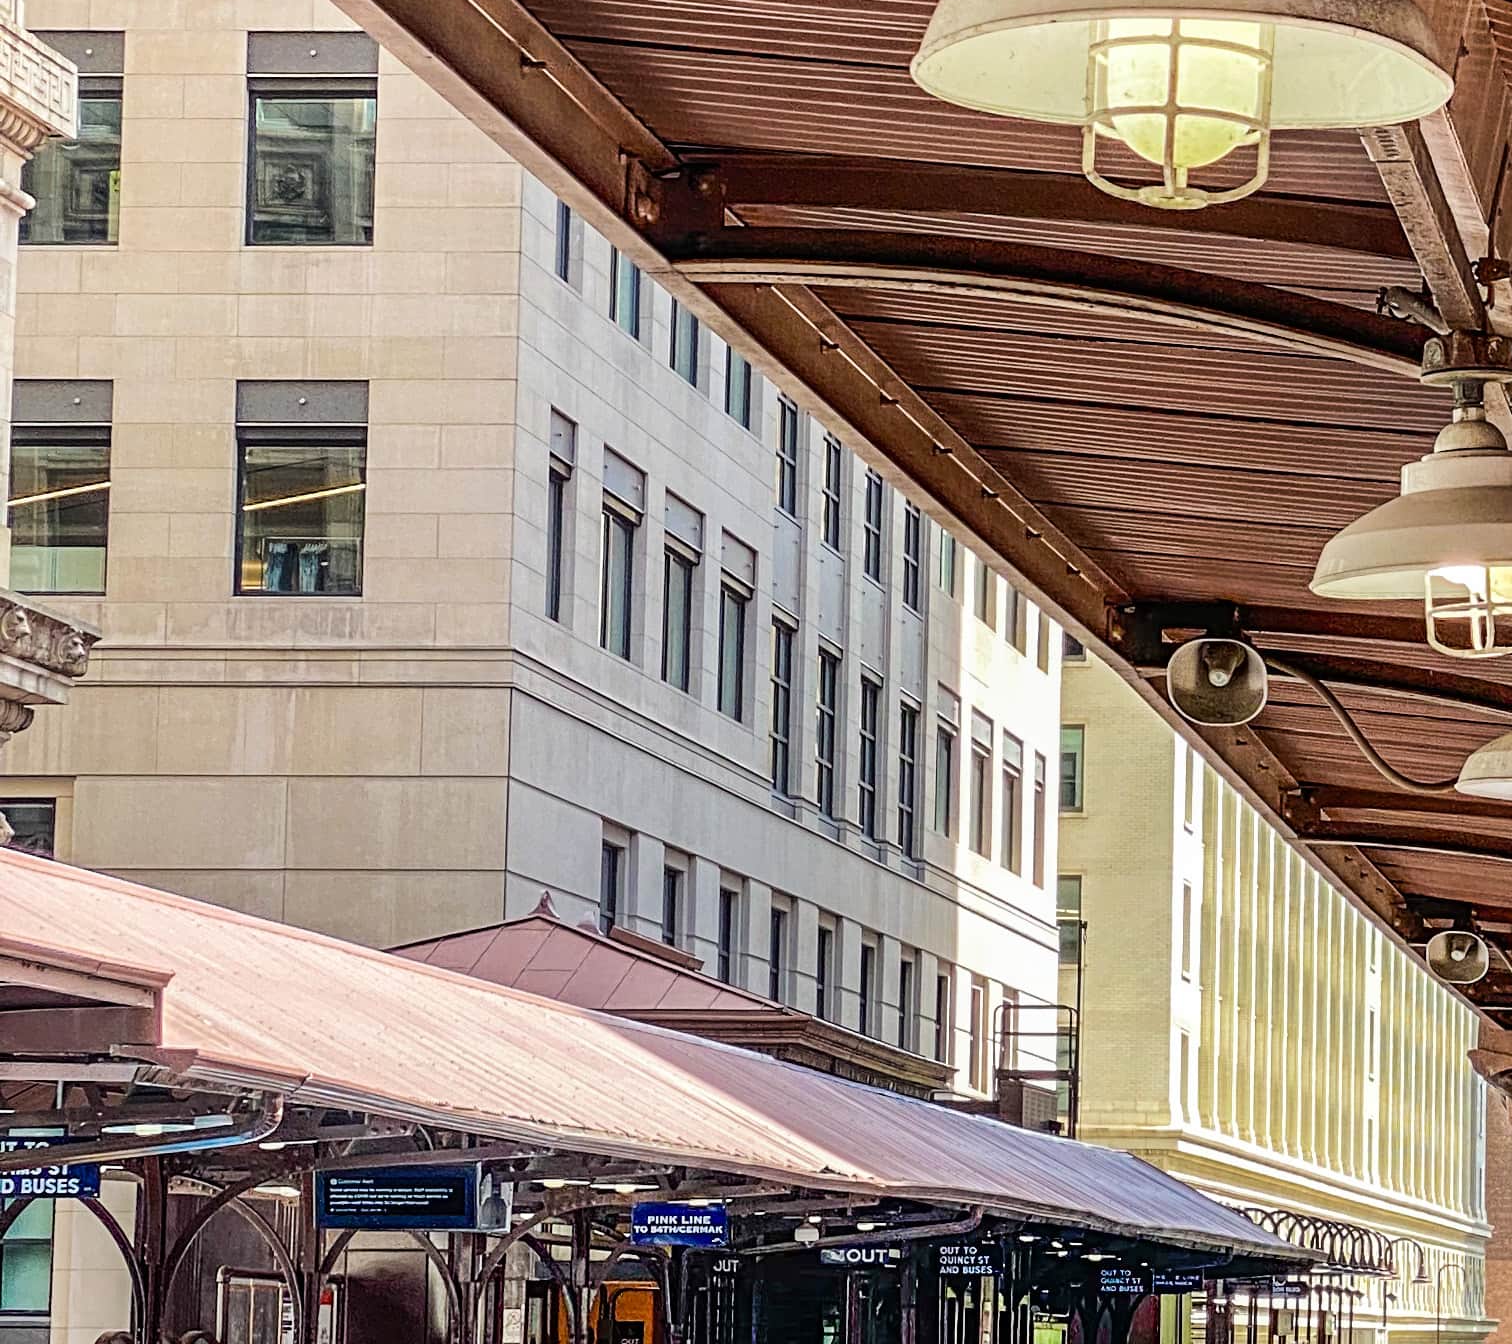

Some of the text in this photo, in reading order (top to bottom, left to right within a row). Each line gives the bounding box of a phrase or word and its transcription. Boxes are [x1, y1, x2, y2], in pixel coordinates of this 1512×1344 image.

[21, 1178, 80, 1194] BUSES
[647, 1216, 711, 1224] PINK LINE
[650, 1226, 723, 1234] 54TH/CERMAK
[846, 1249, 888, 1262] OUT
[940, 1256, 990, 1264] QUINCY ST
[940, 1266, 993, 1274] AND BUSES
